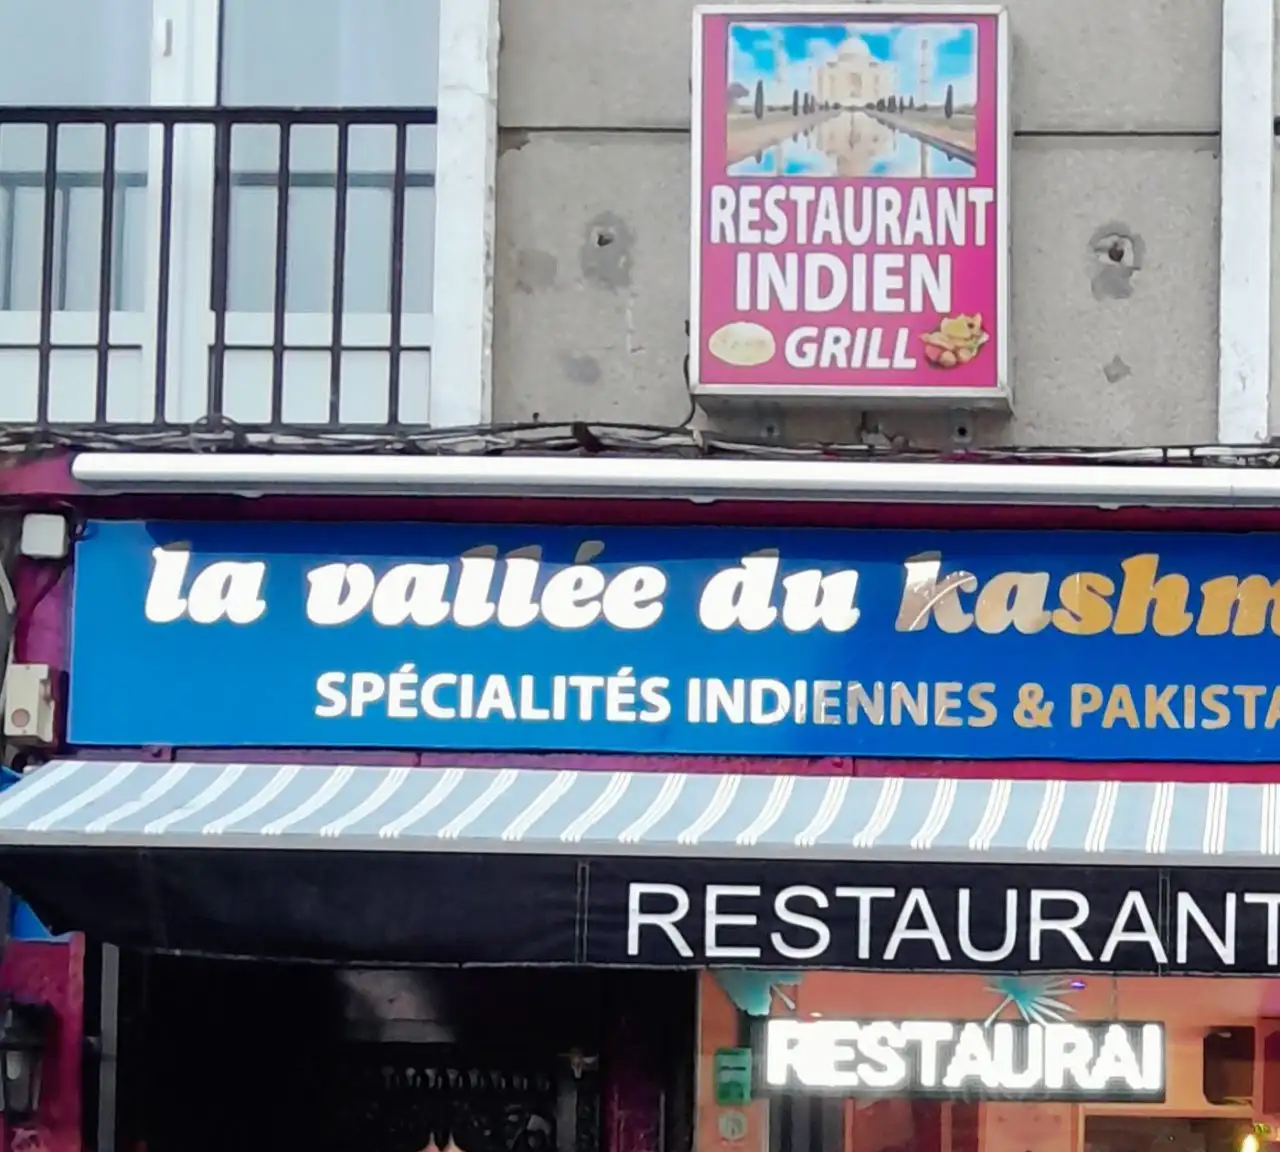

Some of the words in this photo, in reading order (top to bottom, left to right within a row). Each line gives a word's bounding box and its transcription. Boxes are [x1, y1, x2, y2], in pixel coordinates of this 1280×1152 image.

[710, 184, 994, 246] RESTAURANT
[736, 251, 952, 313] INDIEN
[784, 326, 917, 369] GRILL
[144, 542, 267, 624] la
[306, 541, 668, 631] vallée
[699, 549, 861, 632] du
[314, 664, 670, 724] SPÉCIALITÉS
[687, 675, 998, 728] INDIENNES
[1012, 684, 1055, 729] &
